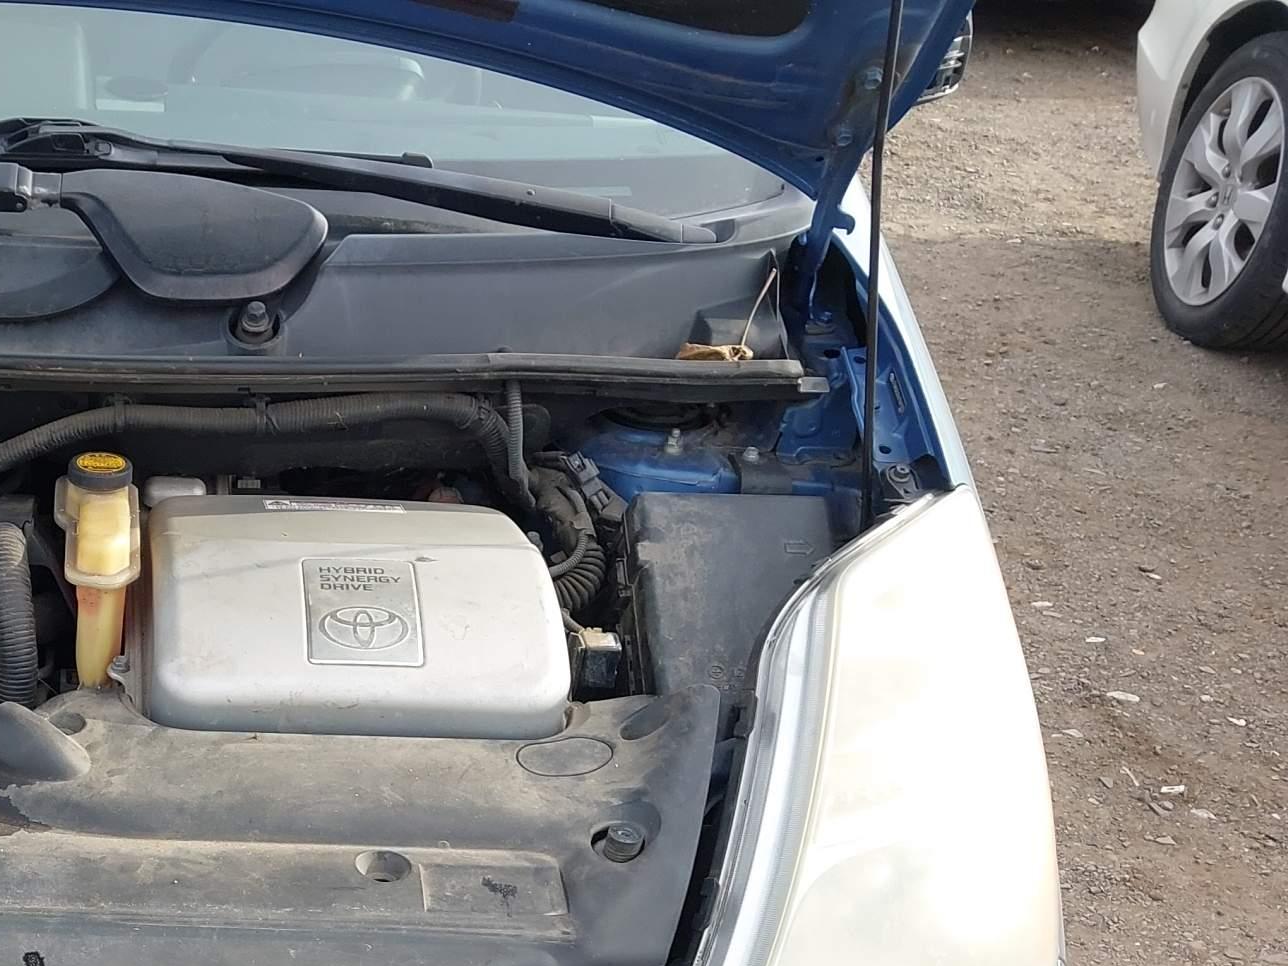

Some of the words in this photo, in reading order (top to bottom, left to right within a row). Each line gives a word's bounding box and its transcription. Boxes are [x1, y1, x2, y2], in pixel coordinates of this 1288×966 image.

[318, 566, 385, 575] HYBRID
[319, 574, 401, 584] SYNERGY
[319, 583, 374, 592] DRIVE
